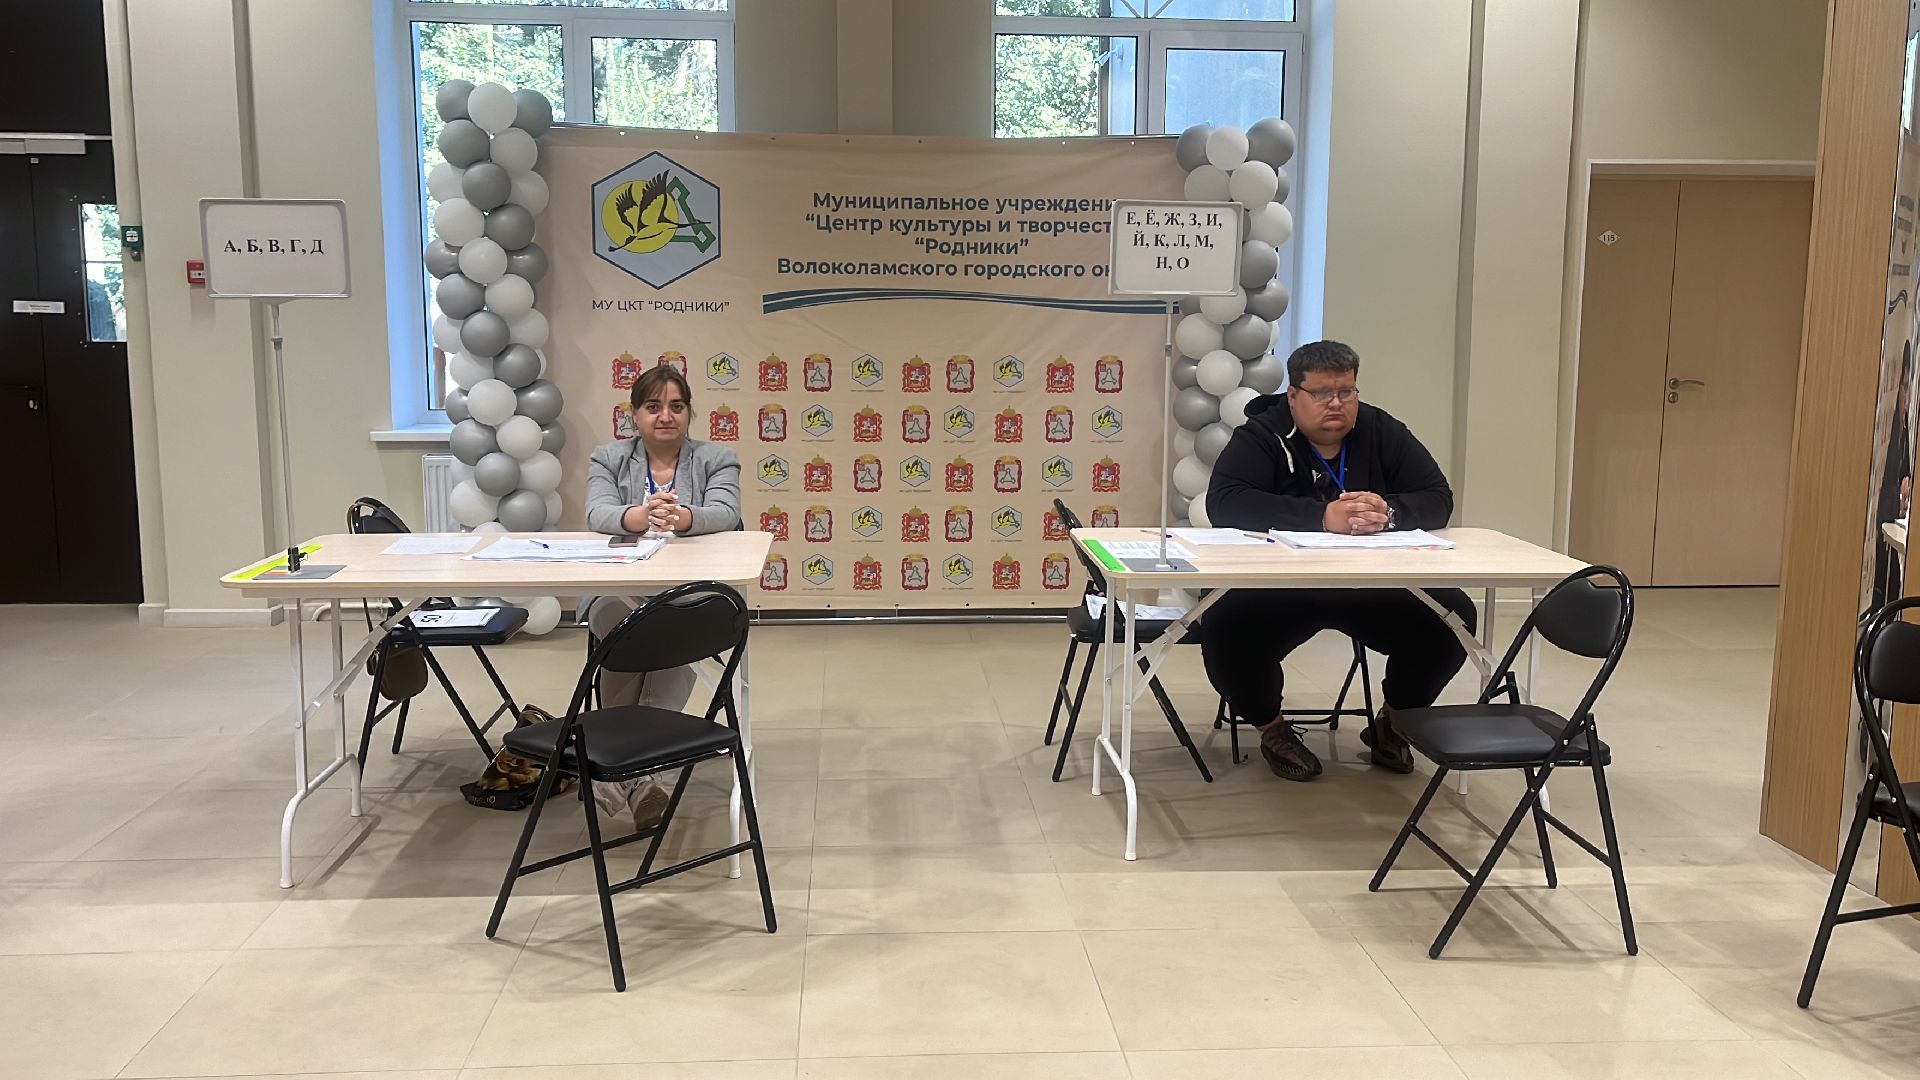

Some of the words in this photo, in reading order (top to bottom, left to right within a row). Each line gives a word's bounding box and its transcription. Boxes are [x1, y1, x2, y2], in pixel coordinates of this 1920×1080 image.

[813, 192, 989, 212] Муниципальное
[805, 213, 883, 235] “Центр
[889, 218, 991, 236] культуры
[998, 220, 1011, 233] и
[1126, 211, 1141, 227] Е,
[1145, 209, 1160, 228] Ё,
[1164, 212, 1185, 228] Ж,
[1188, 212, 1202, 228] З,
[1206, 213, 1222, 229] И,
[224, 239, 242, 255] А,
[247, 239, 263, 255] Б,
[268, 239, 285, 255] В,
[290, 239, 306, 255] Г,
[310, 239, 324, 255] Д
[914, 237, 1029, 256] “Родники”
[1133, 230, 1149, 248] Й,
[1154, 234, 1170, 249] К,
[1173, 234, 1190, 249] Л,
[1194, 234, 1214, 250] М,
[1603, 234, 1616, 242] 115
[777, 258, 958, 276] Волоколамского
[964, 264, 1085, 280] городского
[1156, 256, 1172, 272] Н,
[1176, 257, 1190, 270] О
[592, 300, 613, 310] МУ
[617, 300, 645, 312] ЦКТ
[648, 300, 730, 313] “РОДНИКИ”
